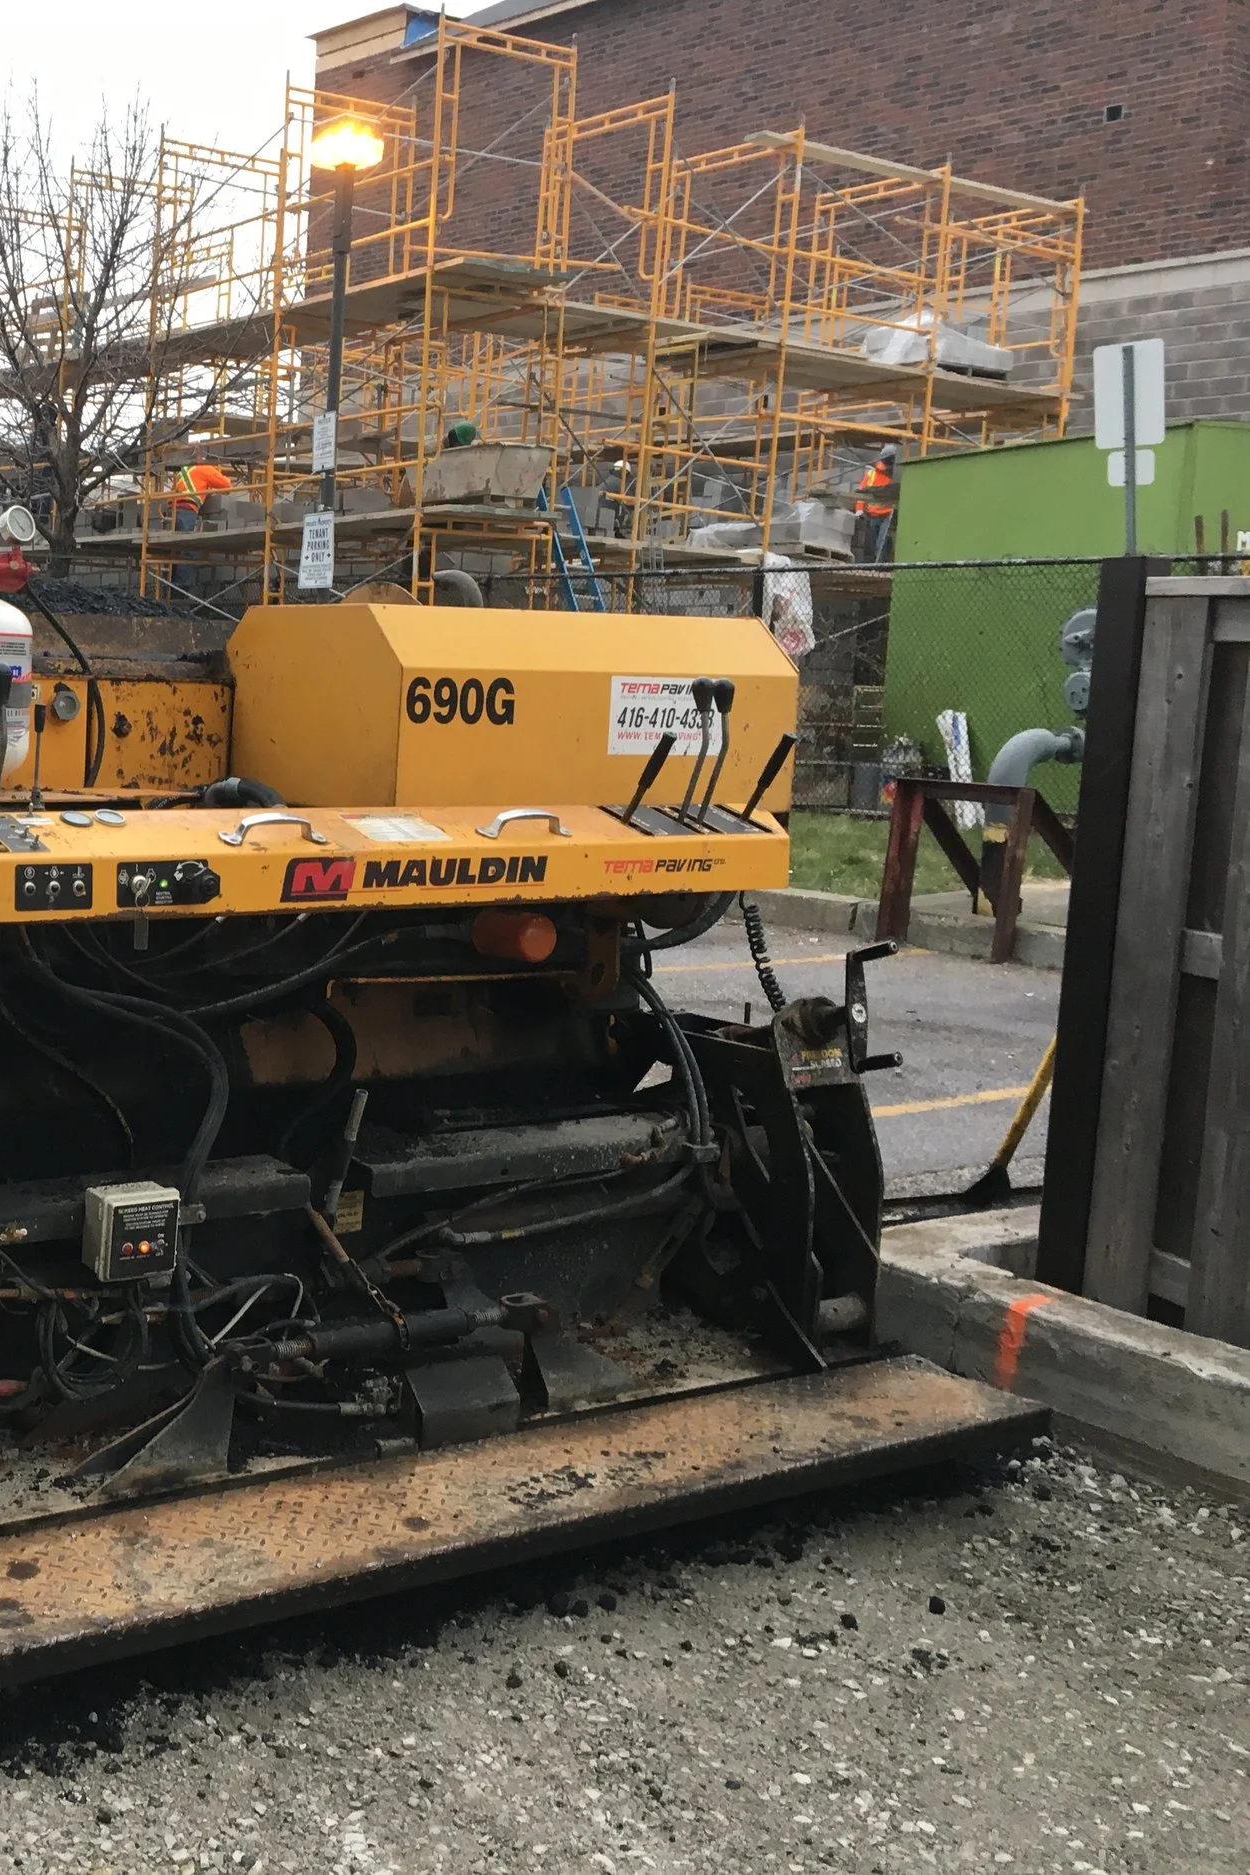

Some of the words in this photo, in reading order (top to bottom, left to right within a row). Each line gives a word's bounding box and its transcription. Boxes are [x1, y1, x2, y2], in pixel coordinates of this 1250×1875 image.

[309, 528, 329, 539] TENANT
[307, 540, 330, 552] PARKING
[311, 552, 325, 563] ONLY
[406, 676, 515, 725] 690G
[362, 855, 548, 889] MAULDIN
